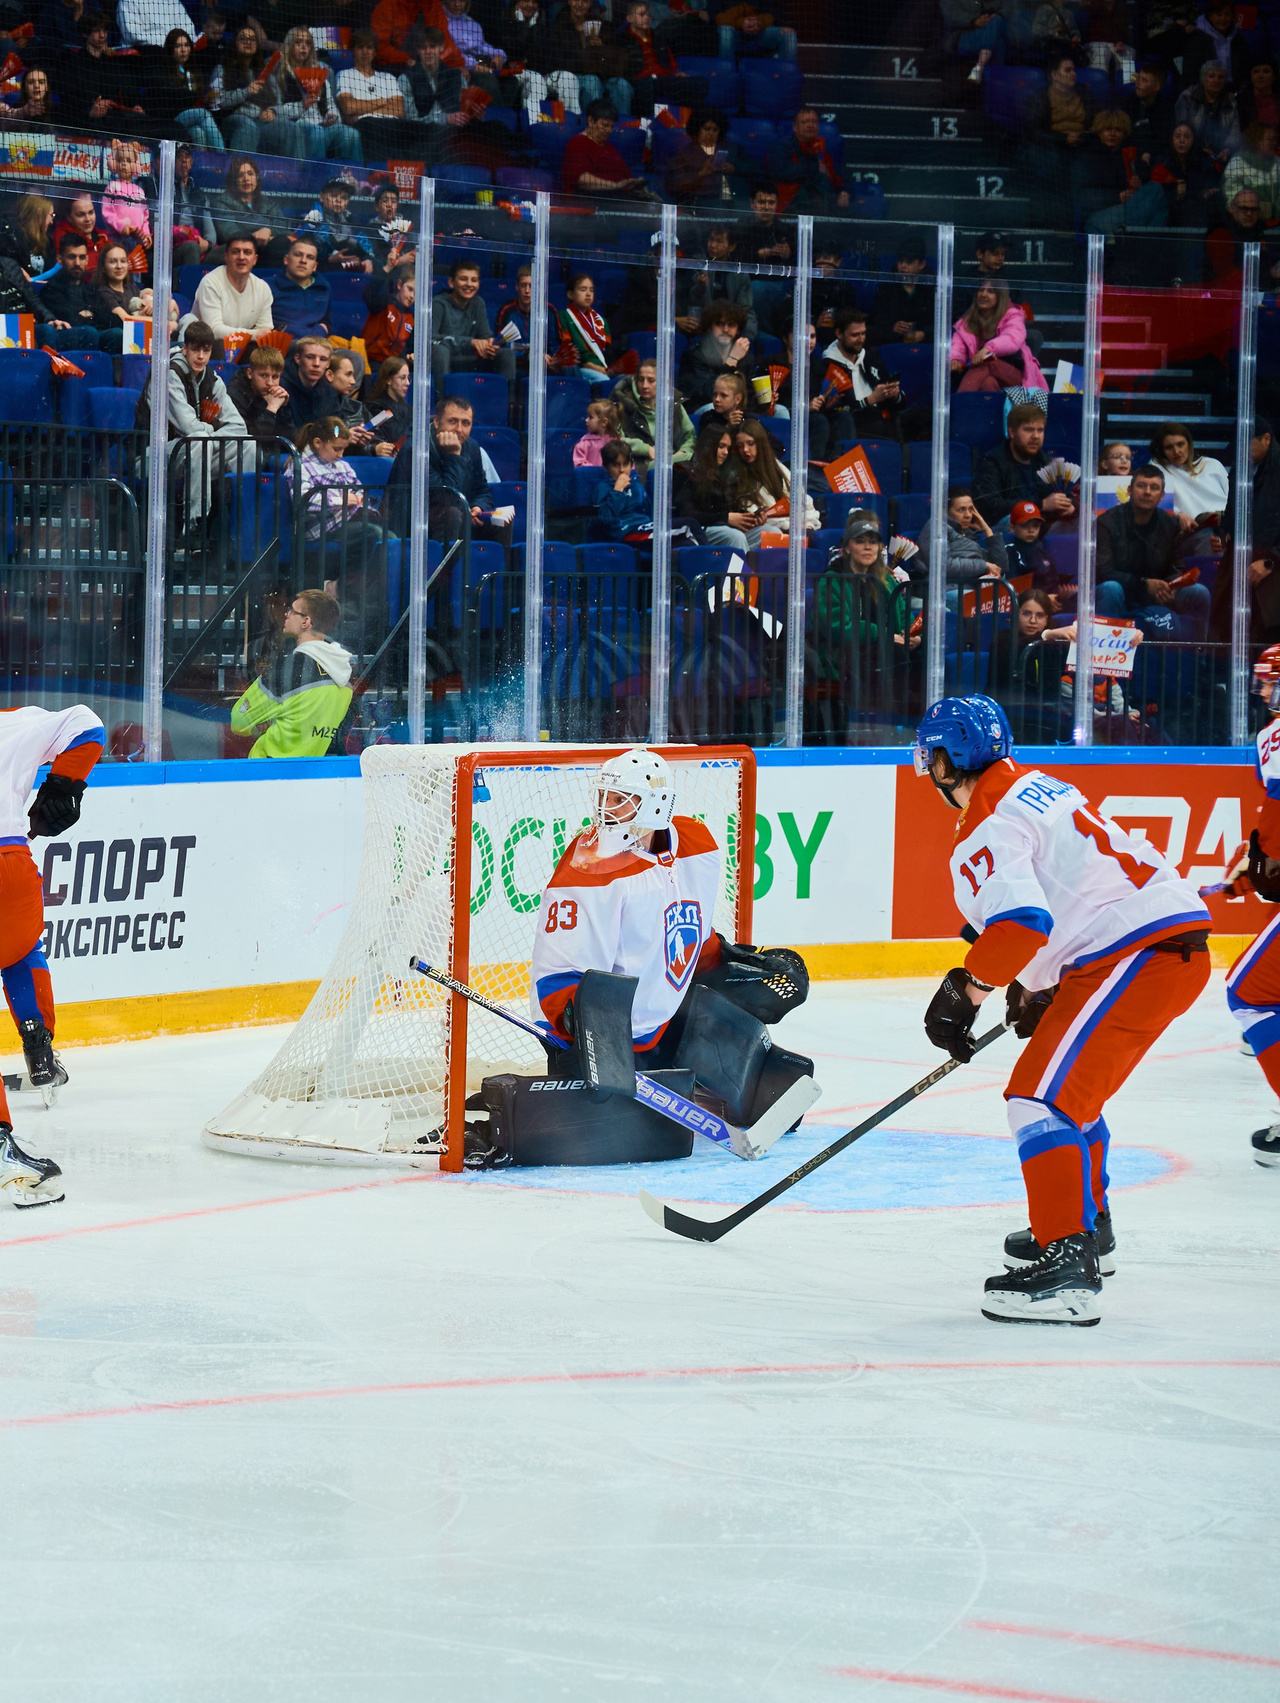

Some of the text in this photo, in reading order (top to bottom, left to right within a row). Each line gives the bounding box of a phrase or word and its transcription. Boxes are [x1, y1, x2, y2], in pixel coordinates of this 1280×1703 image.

[892, 58, 918, 79] 14
[931, 117, 959, 140] 13
[976, 176, 1004, 198] 12
[1024, 241, 1045, 263] 11
[926, 734, 943, 742] CCM
[43, 835, 197, 907] СПОРТ
[960, 846, 995, 898] 17
[544, 899, 578, 933] 83
[45, 910, 186, 960] ЭКСПРЕСС
[913, 1057, 963, 1096] CCM
